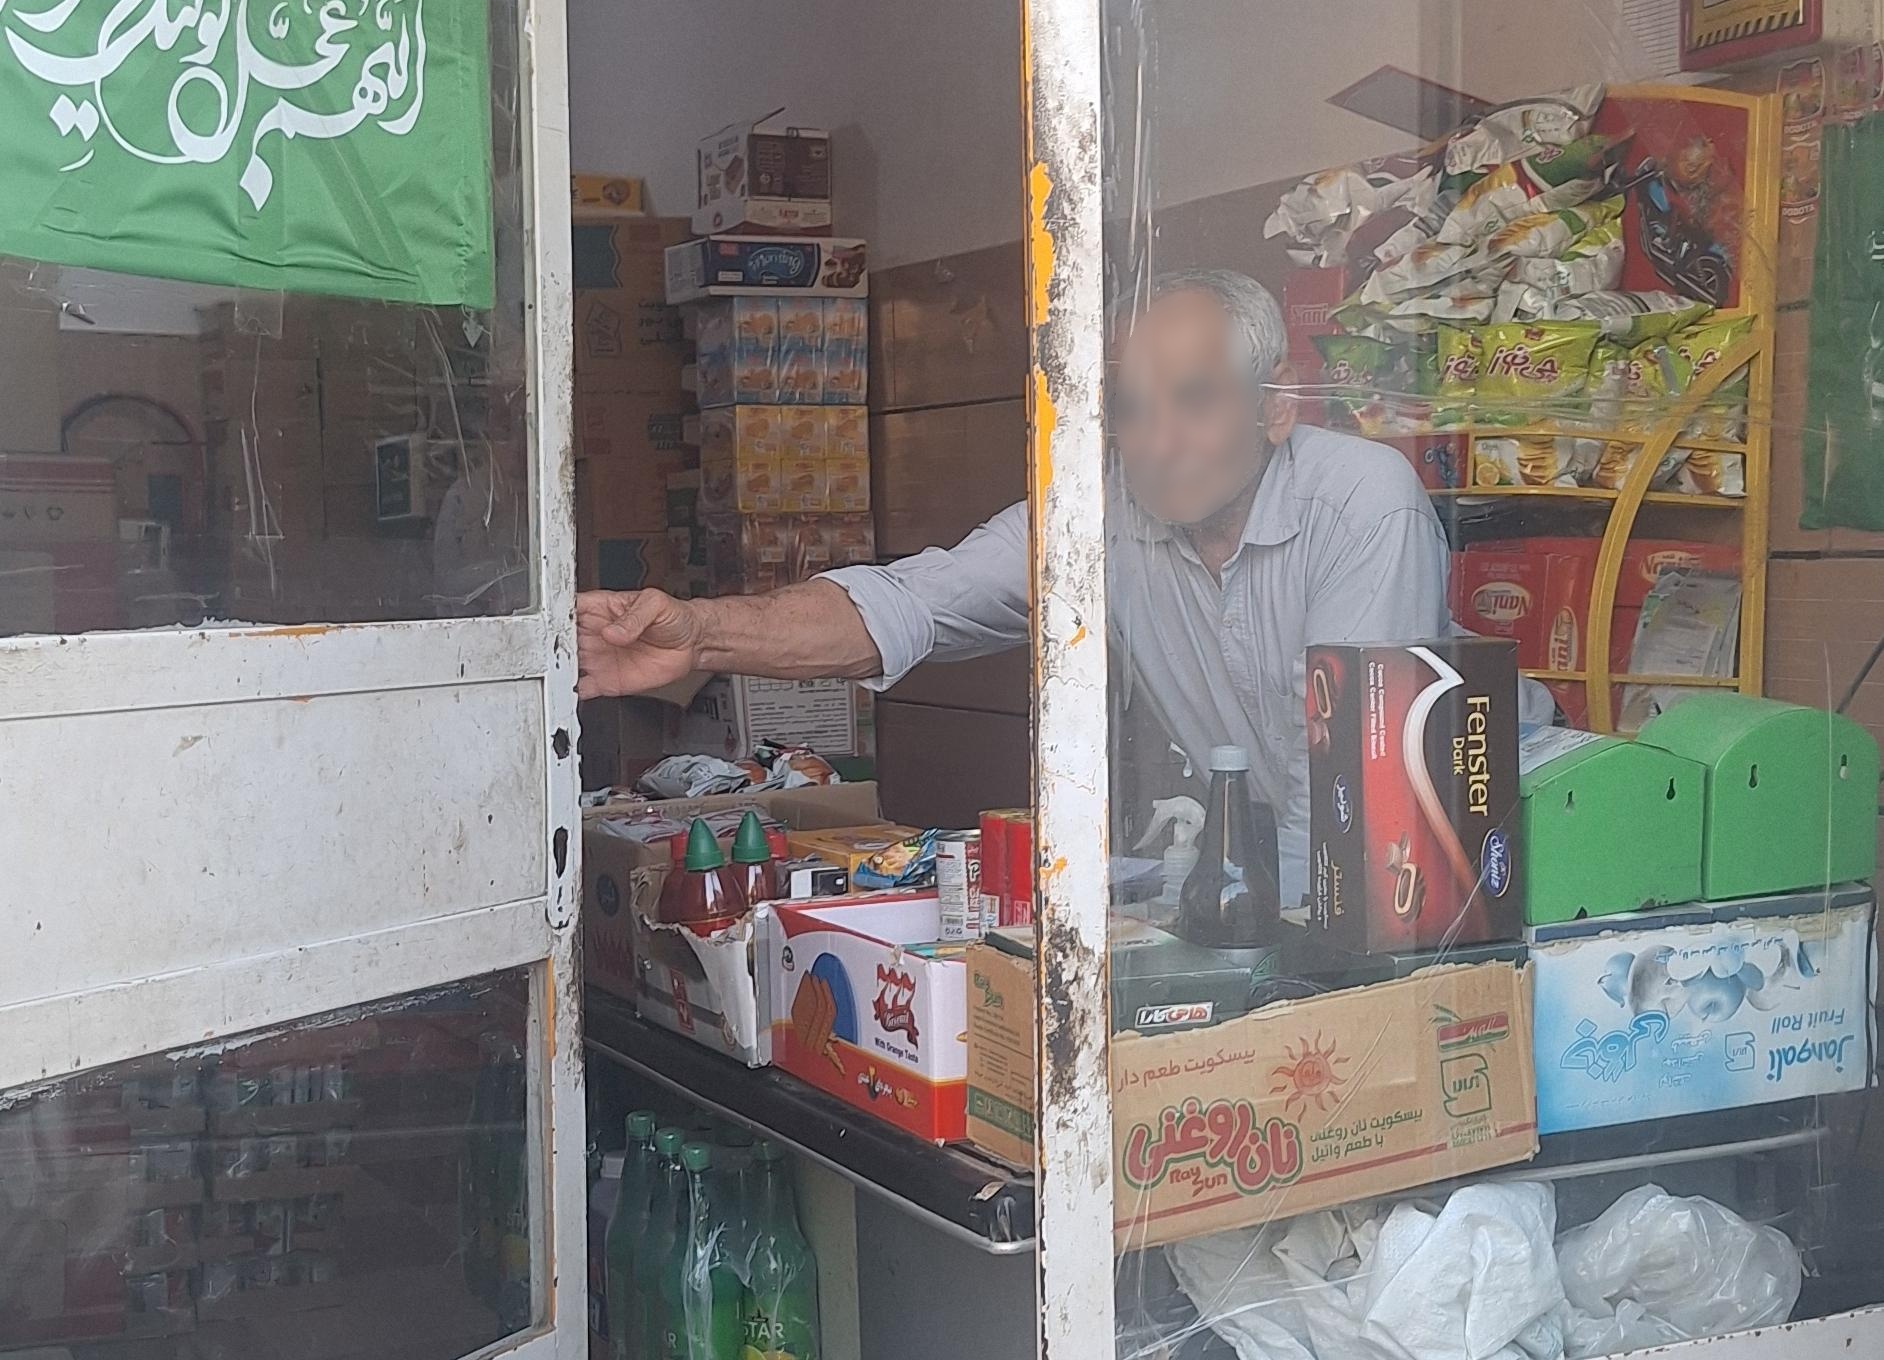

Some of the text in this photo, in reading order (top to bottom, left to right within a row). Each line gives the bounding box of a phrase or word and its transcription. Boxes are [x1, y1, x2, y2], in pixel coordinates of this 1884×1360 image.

[1452, 737, 1464, 776] Dark
[1467, 695, 1490, 817] Fenster
[1490, 834, 1508, 890] Shoniz
[1772, 1008, 1845, 1034] Fruit Roll
[1117, 1047, 1256, 1093] بیسکویت طعم دار
[1560, 1010, 1670, 1084] جنگلی
[1765, 1034, 1854, 1084] jangali
[1125, 1097, 1254, 1185] روغنی
[1309, 1108, 1423, 1142] بیسکویت نان روغنی
[1234, 1117, 1300, 1192] نان
[1311, 1134, 1384, 1163] با طعم وانیل
[1169, 1165, 1199, 1184] Ray
[1191, 1172, 1228, 1197] Sun
